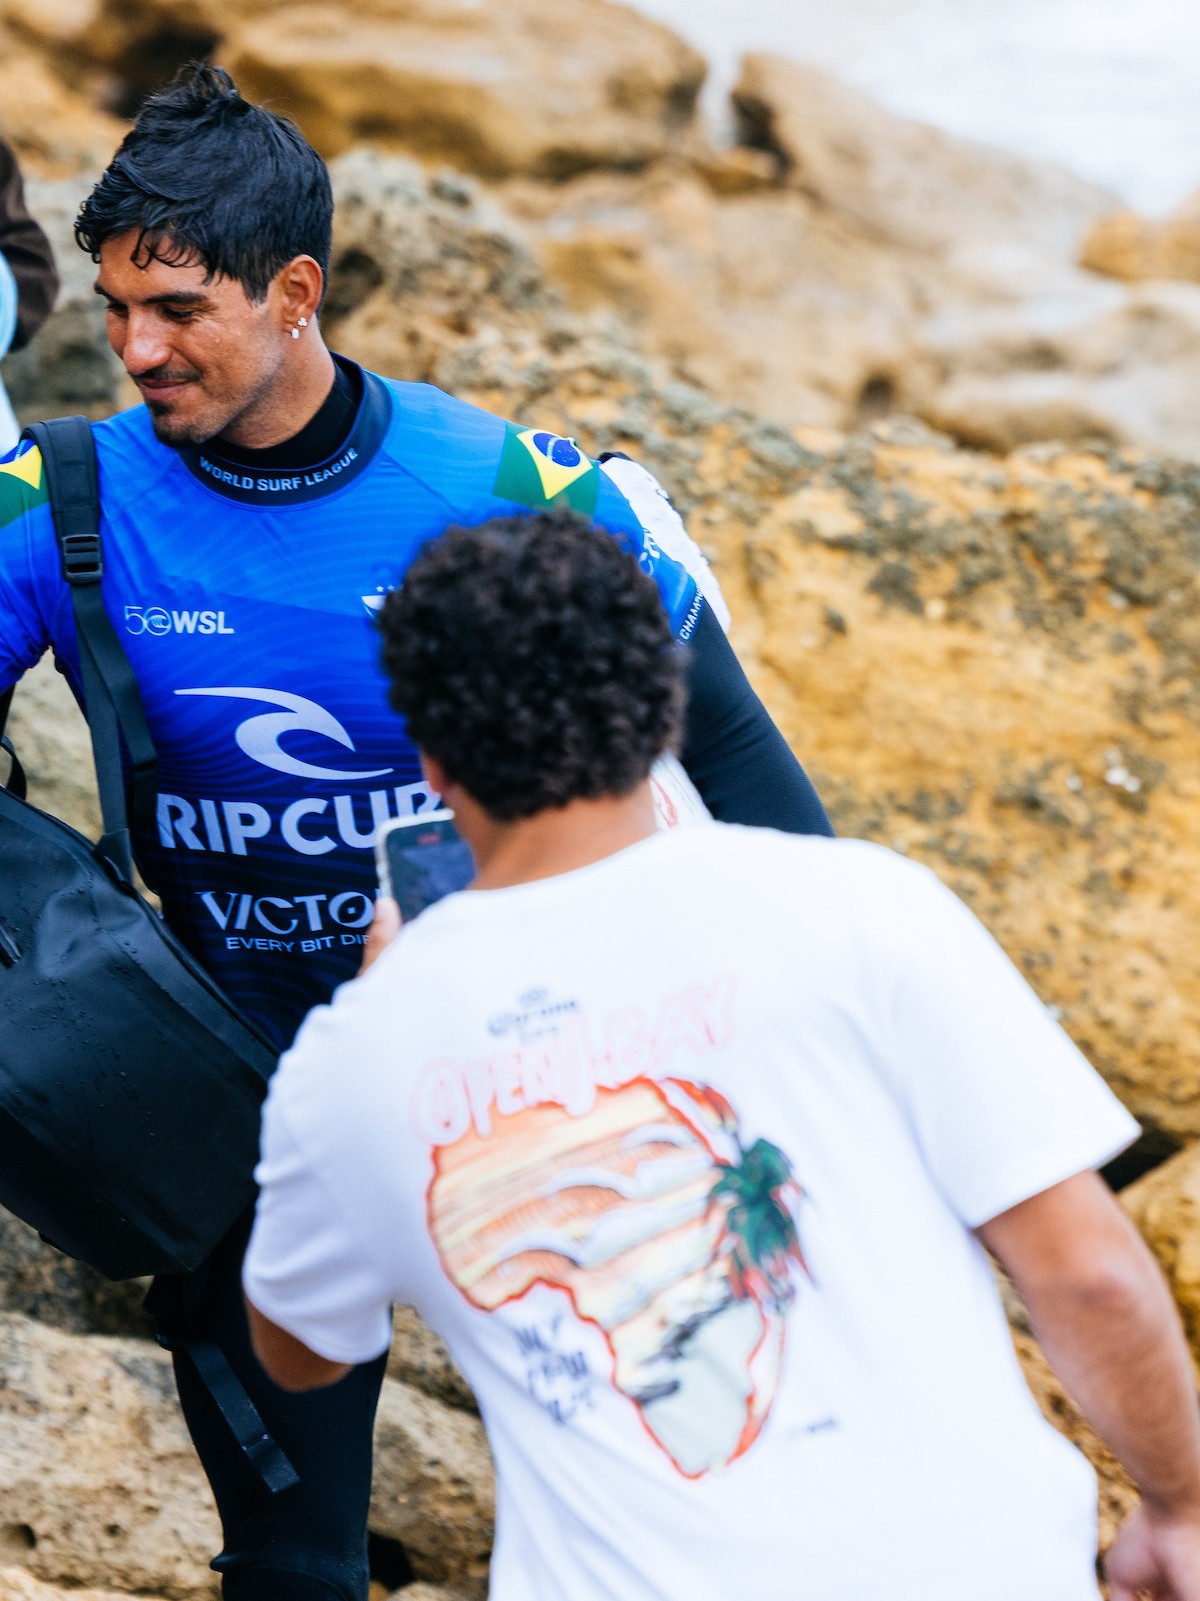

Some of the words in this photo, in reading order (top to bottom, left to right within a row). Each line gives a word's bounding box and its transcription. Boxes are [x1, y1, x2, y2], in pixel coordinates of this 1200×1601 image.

[200, 456, 254, 489] WORLD
[256, 477, 302, 491] SURF
[305, 447, 359, 486] LEAGUE
[156, 793, 272, 856] RIP
[280, 780, 442, 856] CUR
[194, 889, 380, 935] VICTO
[225, 936, 295, 953] EVERY
[300, 935, 335, 953] BIT
